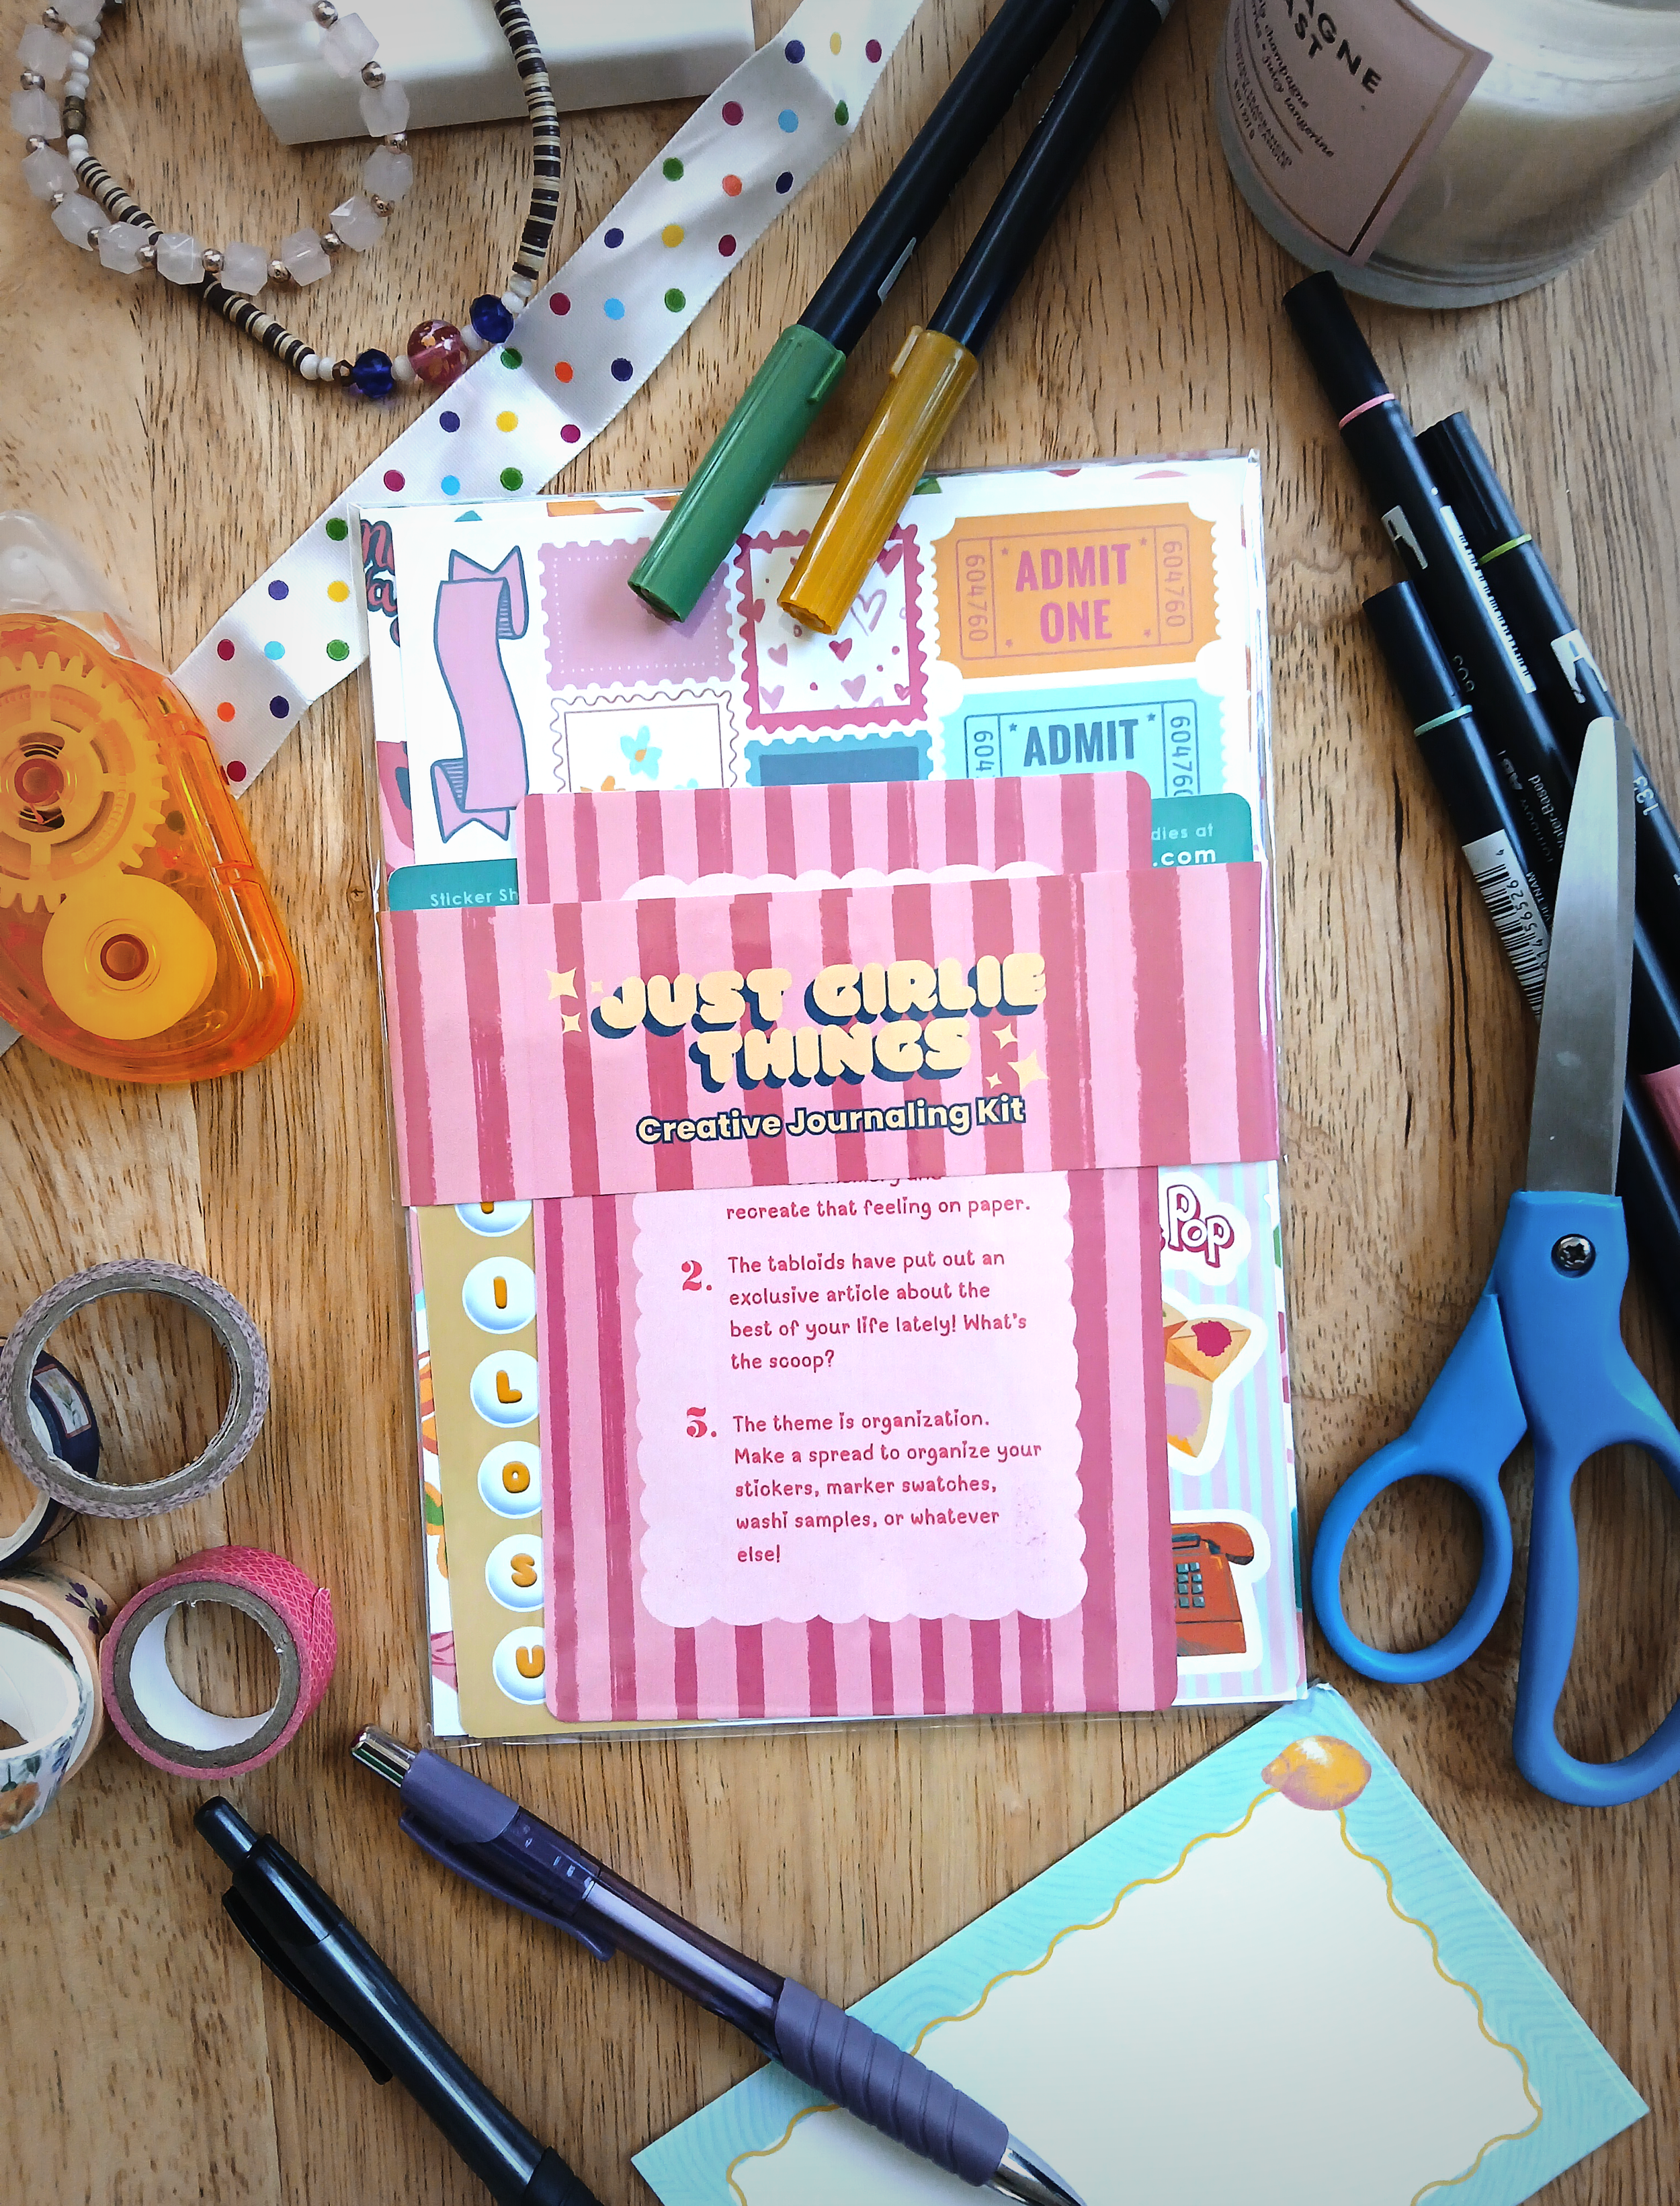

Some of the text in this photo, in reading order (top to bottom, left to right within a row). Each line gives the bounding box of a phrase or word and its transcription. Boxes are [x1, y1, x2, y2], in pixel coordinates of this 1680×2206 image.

[1265, 24, 1309, 109] champagne
[1284, 97, 1335, 158] tangerine
[1015, 542, 1131, 593] ADMIT
[1161, 539, 1187, 629] 604760
[964, 554, 991, 642] 604760
[1040, 599, 1113, 645] ONE
[1023, 718, 1140, 767] ADMIT
[1195, 822, 1214, 837] at
[430, 891, 493, 908] Sticker
[1505, 879, 1538, 933] 56526
[591, 952, 1047, 1039] JUST GIRLIE
[688, 1017, 972, 1093] THINGS
[636, 1093, 1026, 1145] Creative Journaling Kit
[726, 1196, 1030, 1221] recreate that feeling on paper.
[681, 1260, 712, 1291] 2.
[727, 1249, 1005, 1274] The tabloids have put out an
[729, 1281, 990, 1306] exclusive article about the
[730, 1312, 1027, 1341] best of your life lately! What's
[730, 1349, 835, 1373] the scoop?
[496, 1370, 523, 1404] L
[732, 1408, 989, 1436] The theme is organization.
[734, 1440, 1042, 1469] Make a spread to organize your
[502, 1461, 531, 1494] O
[735, 1474, 997, 1498] stickers, marker swatches,
[736, 1507, 1000, 1533] washi samples, or whatever
[737, 1543, 780, 1564] else!
[511, 1553, 538, 1588] S
[515, 1645, 546, 1679] U
